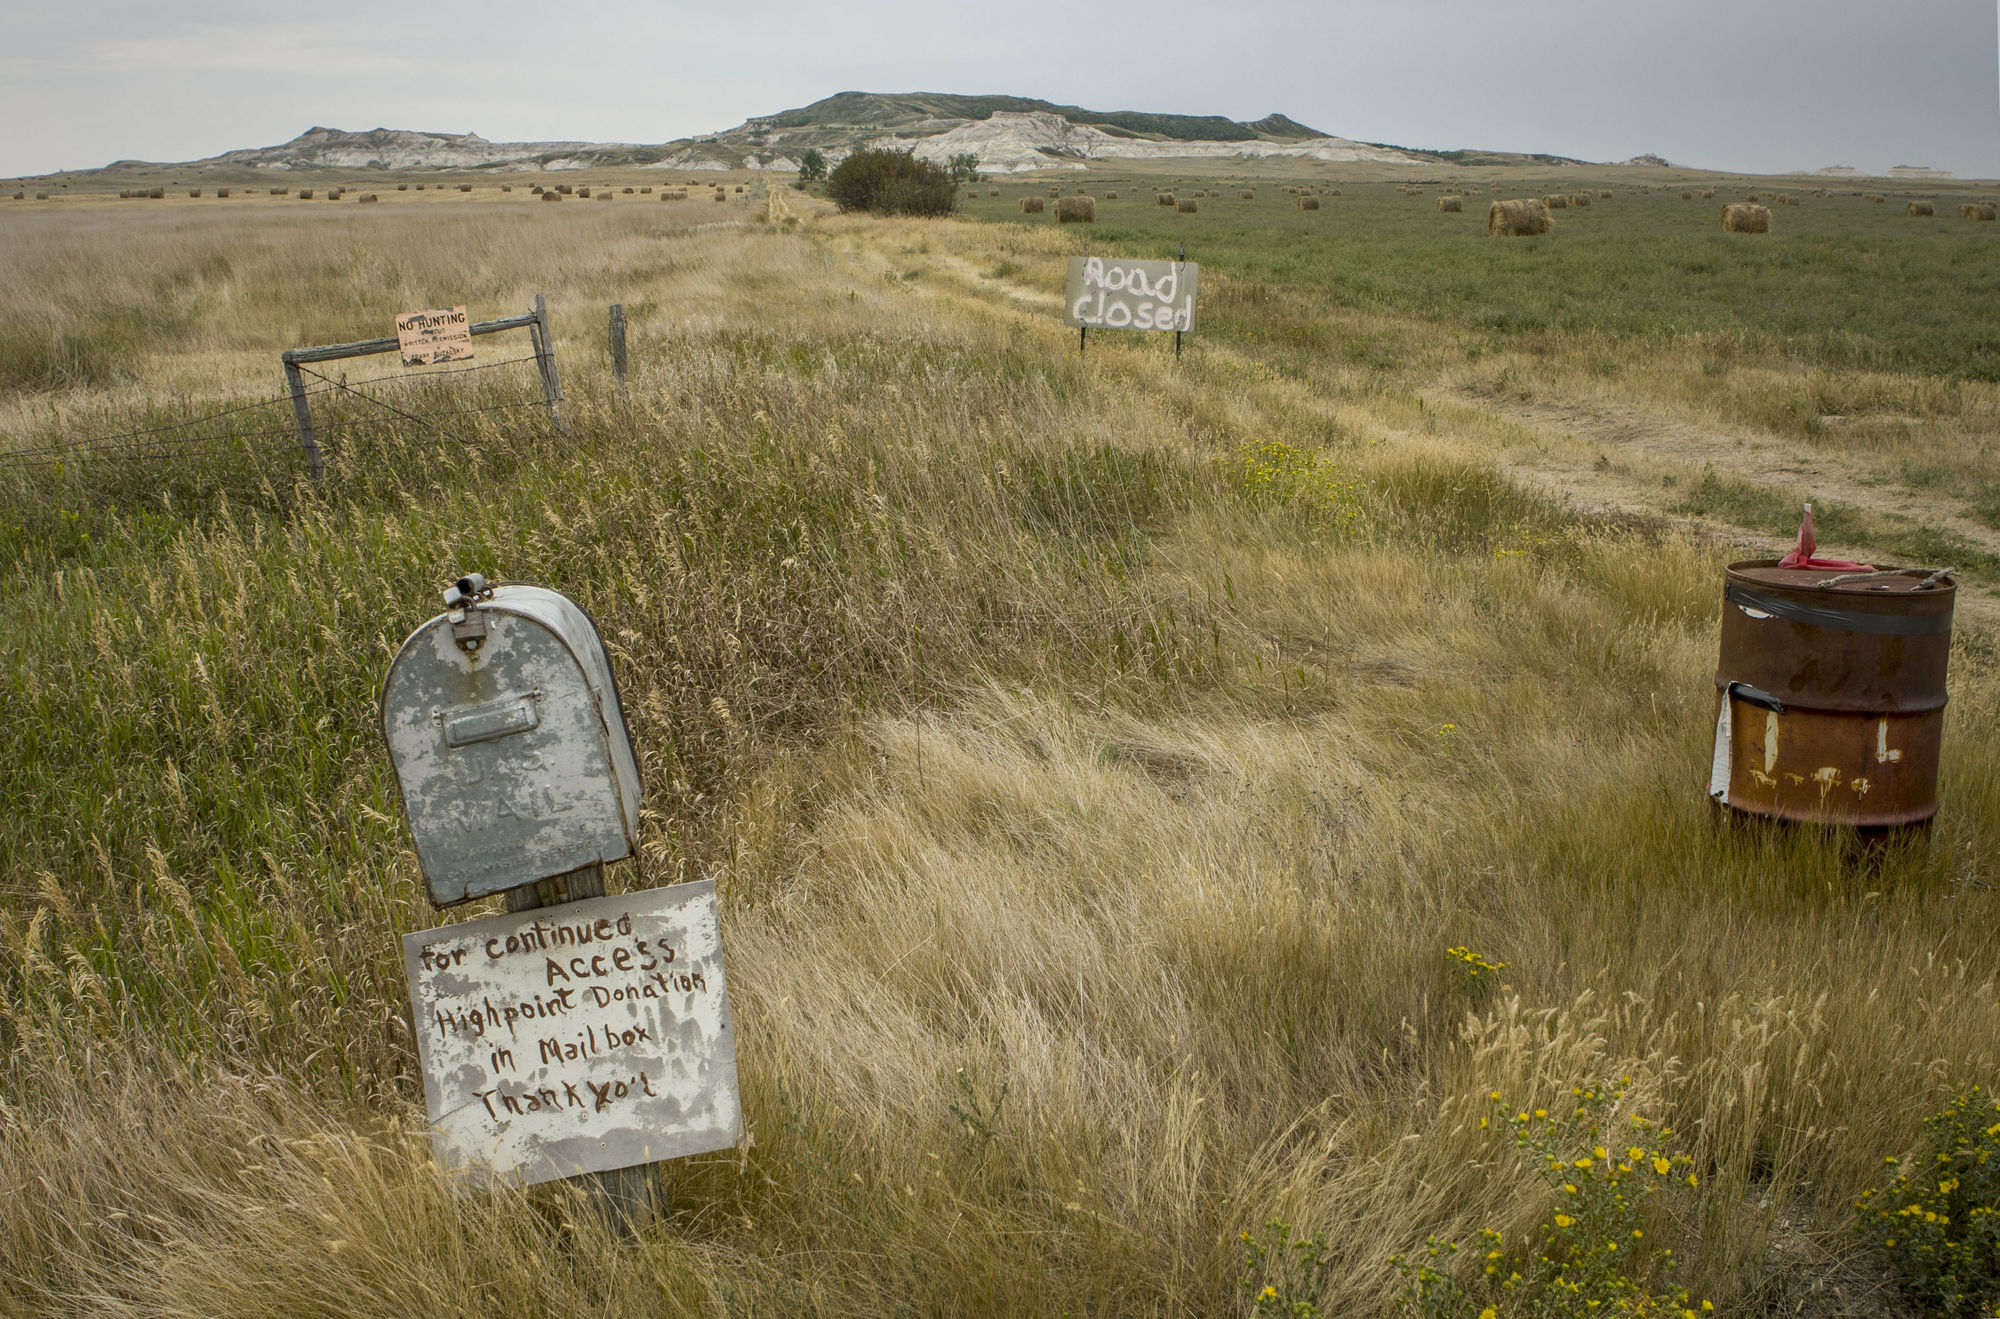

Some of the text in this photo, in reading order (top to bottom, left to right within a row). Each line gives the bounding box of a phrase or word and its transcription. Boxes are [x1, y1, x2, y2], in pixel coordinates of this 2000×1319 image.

[1084, 257, 1177, 304] Road
[398, 321, 414, 332] NO
[418, 313, 465, 329] HUNTING
[485, 912, 632, 959] continued
[589, 971, 708, 1008] Donation
[489, 1042, 517, 1074] in
